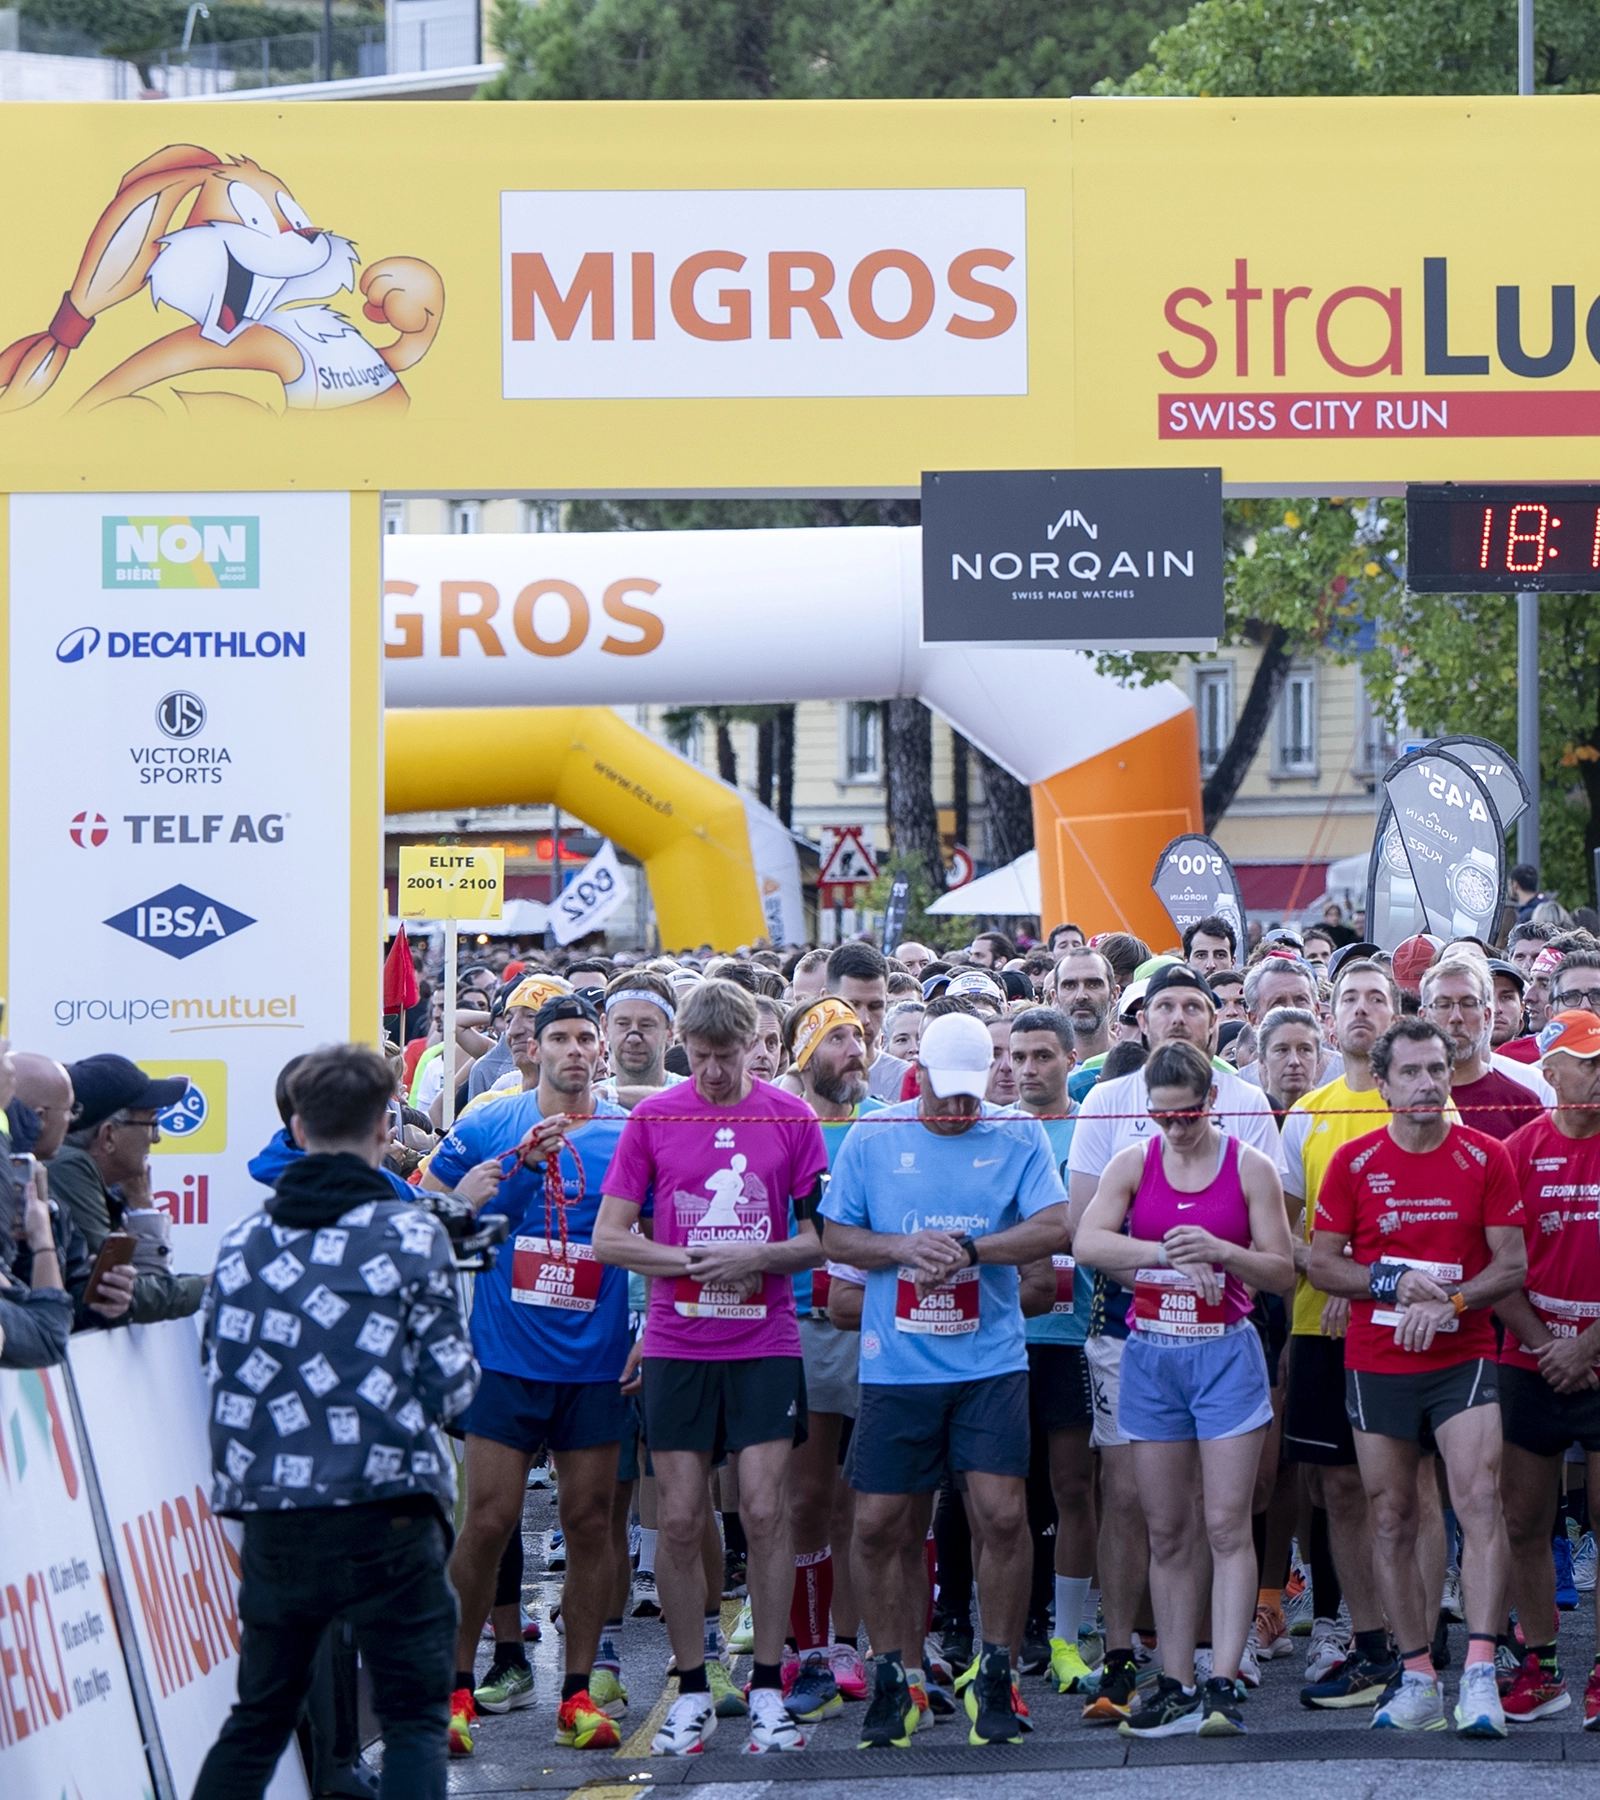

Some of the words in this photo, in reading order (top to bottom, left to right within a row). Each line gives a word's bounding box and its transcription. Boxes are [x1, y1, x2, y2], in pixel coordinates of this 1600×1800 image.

[511, 248, 1017, 341] MIGROS
[1168, 401, 1277, 432] SWISS
[1290, 401, 1369, 430] CITY
[1375, 399, 1448, 430] RUN
[116, 524, 246, 564] NON
[951, 549, 1195, 582] NORQAIN
[116, 567, 162, 582] BIÈRE
[1012, 591, 1044, 600] SWISS
[1048, 590, 1078, 599] MADE
[1082, 590, 1135, 599] WATCHES
[107, 631, 306, 659] DECATHLON
[130, 748, 232, 765] VICTORIA
[139, 767, 223, 785] SPORTS
[123, 815, 224, 845] TELF
[430, 857, 475, 868] ELITE
[407, 878, 443, 889] 2001
[459, 879, 497, 889] 2100
[136, 906, 226, 938] IBSA
[54, 994, 297, 1026] groupemutuel
[924, 1214, 990, 1229] MARATÓN
[1401, 1211, 1459, 1224] ilger.com
[578, 1249, 600, 1259] 202
[538, 1264, 575, 1283] 2263
[1437, 1269, 1458, 1279] 2025
[535, 1279, 575, 1295] MATTEO
[550, 1297, 591, 1310] MIGROS
[698, 1291, 741, 1305] ALESSIO
[918, 1294, 955, 1310] 2545
[1160, 1293, 1197, 1311] 2468
[716, 1307, 762, 1317] MIGROS
[910, 1308, 964, 1322] DOMENICO
[1158, 1308, 1198, 1323] VALERIE
[1579, 1306, 1600, 1316] 2025
[933, 1322, 976, 1334] MIGROS
[1175, 1324, 1220, 1335] MIGROS
